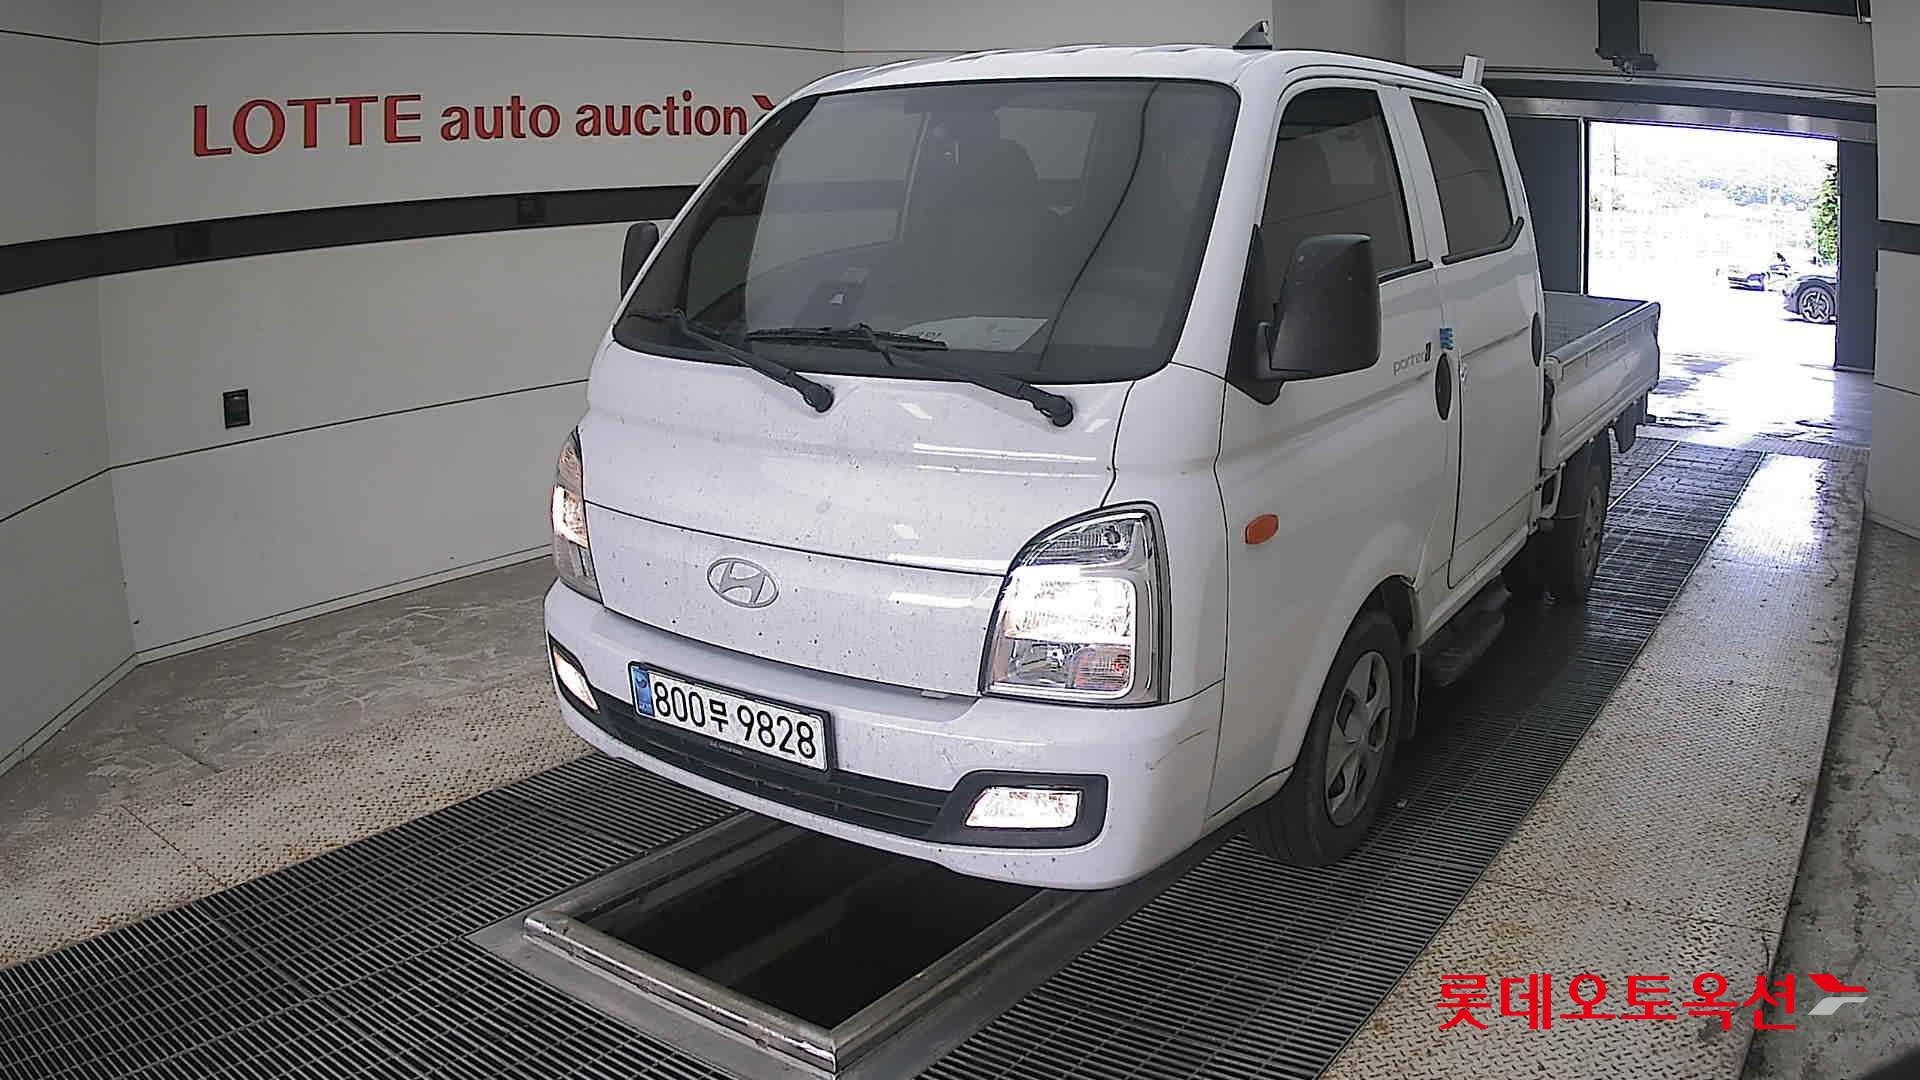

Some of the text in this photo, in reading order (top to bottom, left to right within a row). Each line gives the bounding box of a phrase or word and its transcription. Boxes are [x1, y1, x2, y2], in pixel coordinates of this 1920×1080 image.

[193, 89, 748, 157] LOTTE auto auction
[737, 705, 816, 759] 9828
